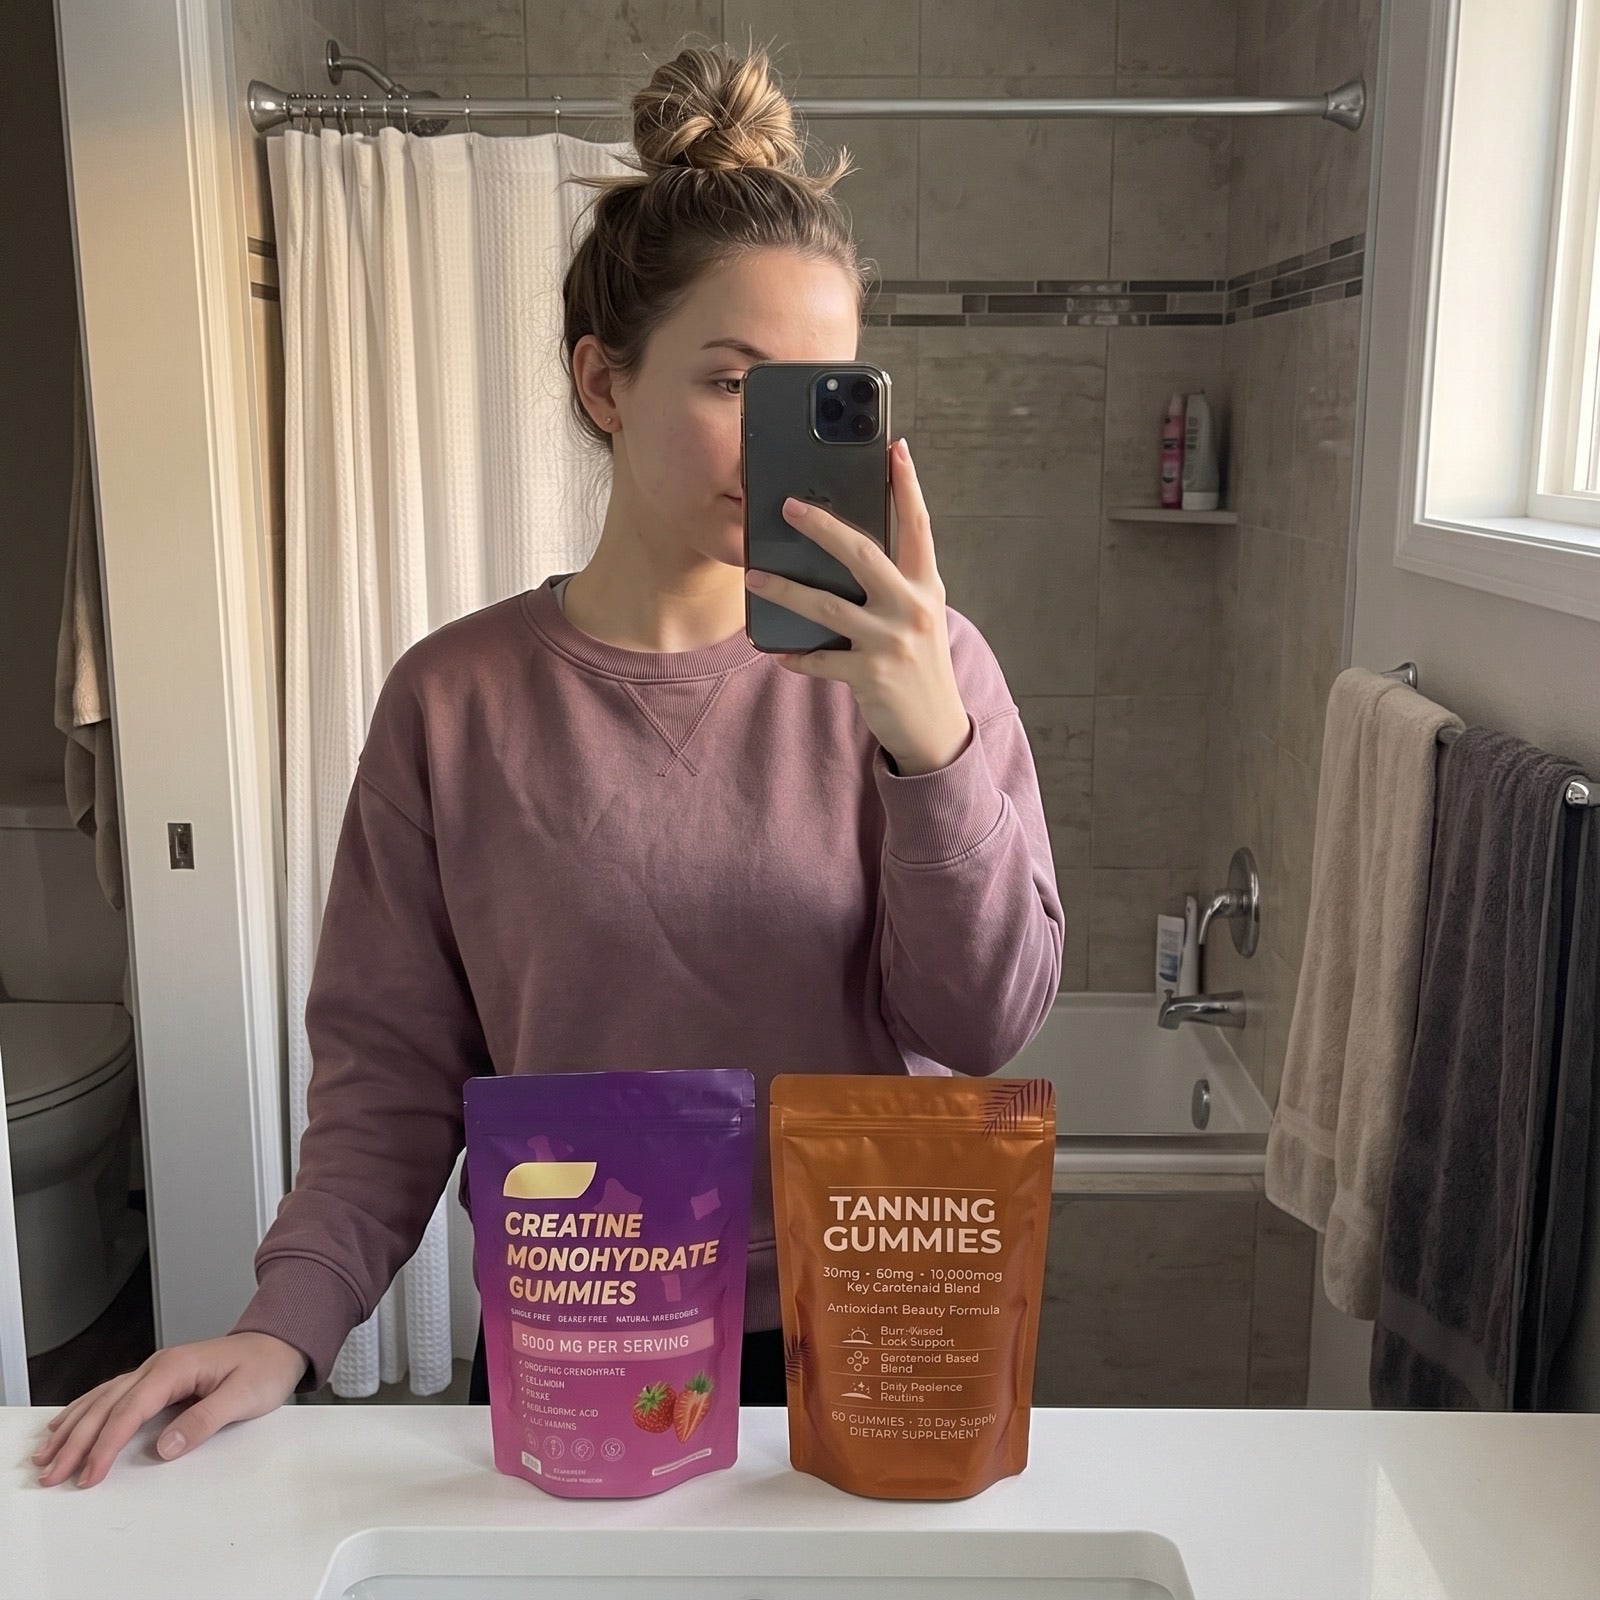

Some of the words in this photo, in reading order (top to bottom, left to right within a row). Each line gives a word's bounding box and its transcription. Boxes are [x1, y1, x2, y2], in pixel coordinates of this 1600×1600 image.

[829, 1195, 996, 1223] TANNING
[505, 1211, 643, 1238] CREATINE
[823, 1226, 1002, 1254] GUMMIES
[507, 1239, 720, 1272] MONOHYDRATE
[823, 1266, 860, 1281] 30mg
[509, 1275, 637, 1305] GUMMIES
[847, 1282, 870, 1294] Key
[944, 1283, 981, 1294] Blend
[827, 1302, 898, 1315] Antioxidant
[902, 1305, 945, 1317] Beauty
[949, 1305, 1000, 1316] Formula
[589, 1315, 608, 1323] FREE
[616, 1315, 650, 1323] NATURAL
[521, 1333, 554, 1352] 5000
[560, 1339, 582, 1353] MG
[588, 1340, 618, 1353] PER
[623, 1335, 689, 1352] SERVING
[880, 1337, 908, 1347] Lock
[910, 1337, 955, 1349] Support
[945, 1353, 979, 1363] Based
[880, 1364, 913, 1374] Blend
[579, 1409, 599, 1417] ACID
[831, 1410, 846, 1422] 60
[849, 1413, 905, 1427] GUMMIES
[935, 1417, 957, 1429] Day
[959, 1413, 997, 1427] Supply
[850, 1426, 899, 1439] DIETARY
[901, 1428, 980, 1440] SUPPLEMENT
